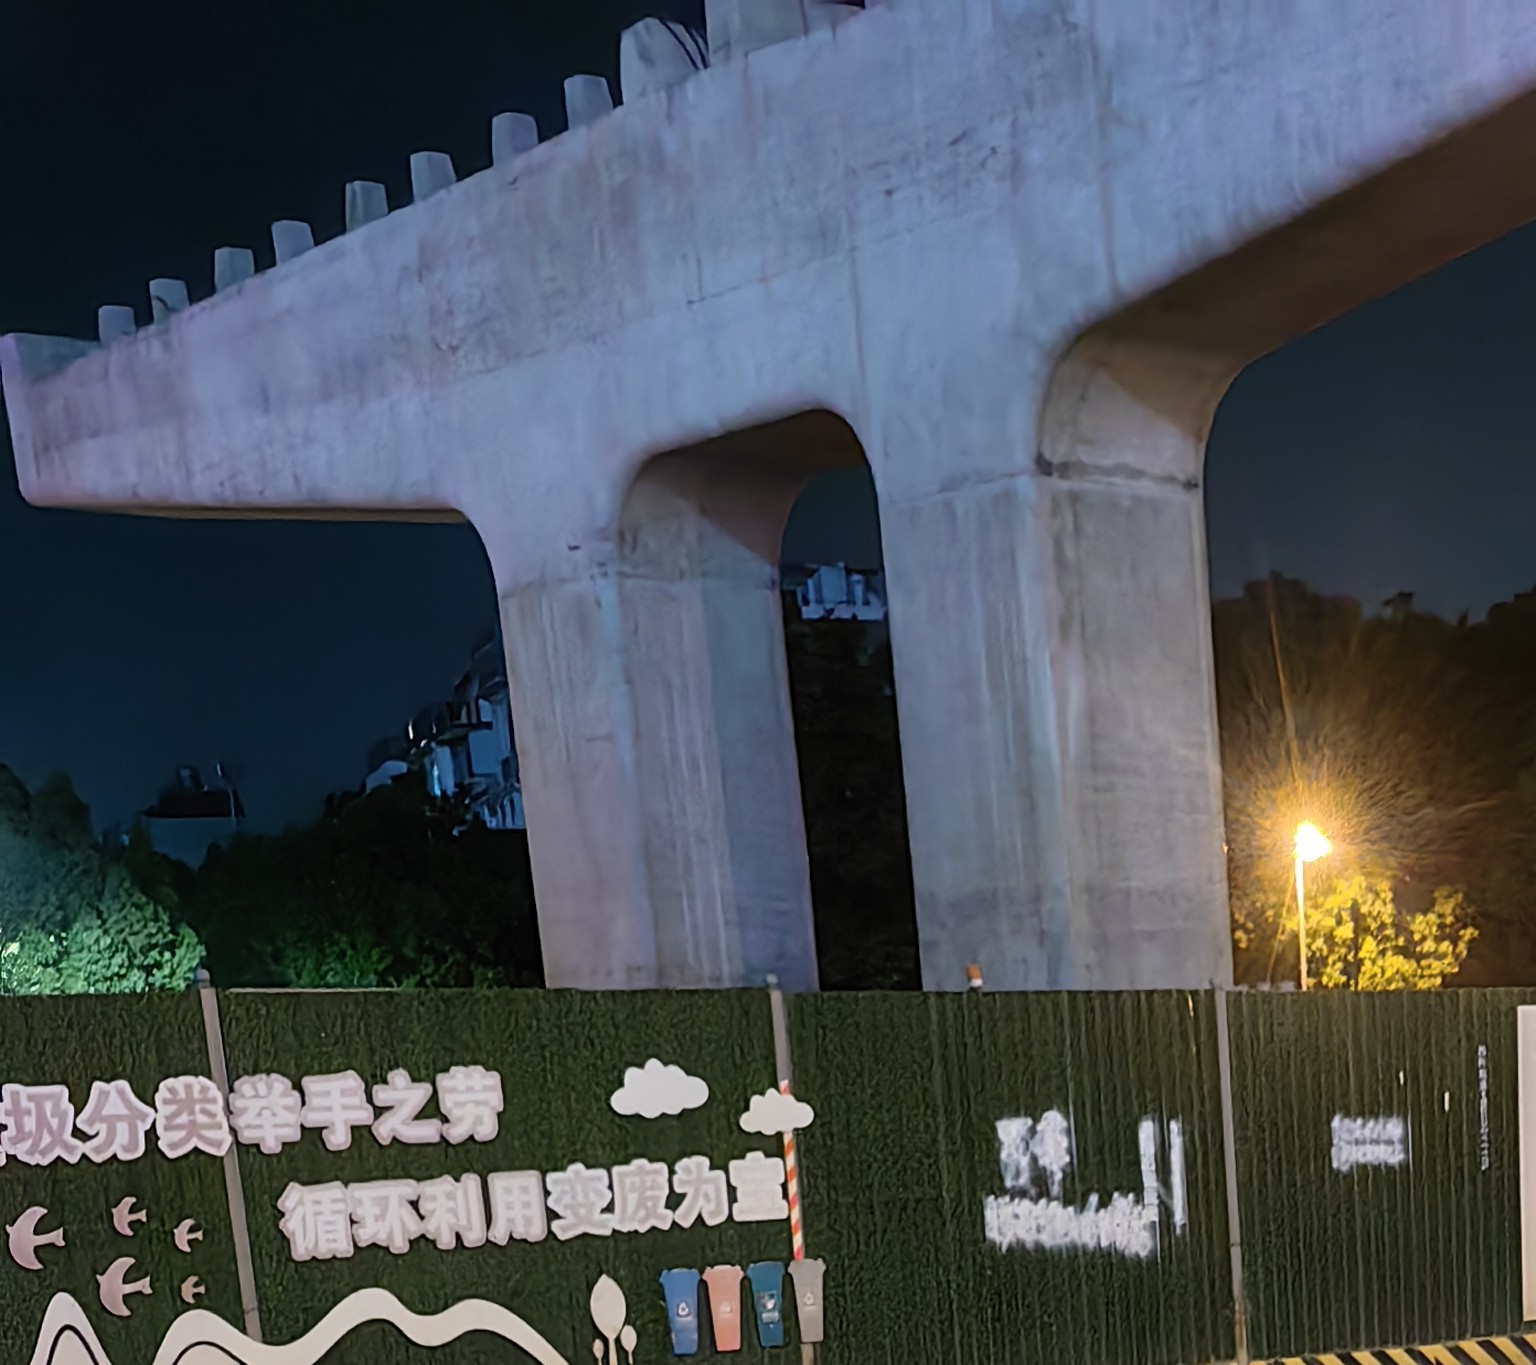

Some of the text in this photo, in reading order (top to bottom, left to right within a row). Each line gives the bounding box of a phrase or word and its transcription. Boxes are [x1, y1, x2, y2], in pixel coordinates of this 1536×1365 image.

[0, 1066, 504, 1167] 圾分类举手之劳
